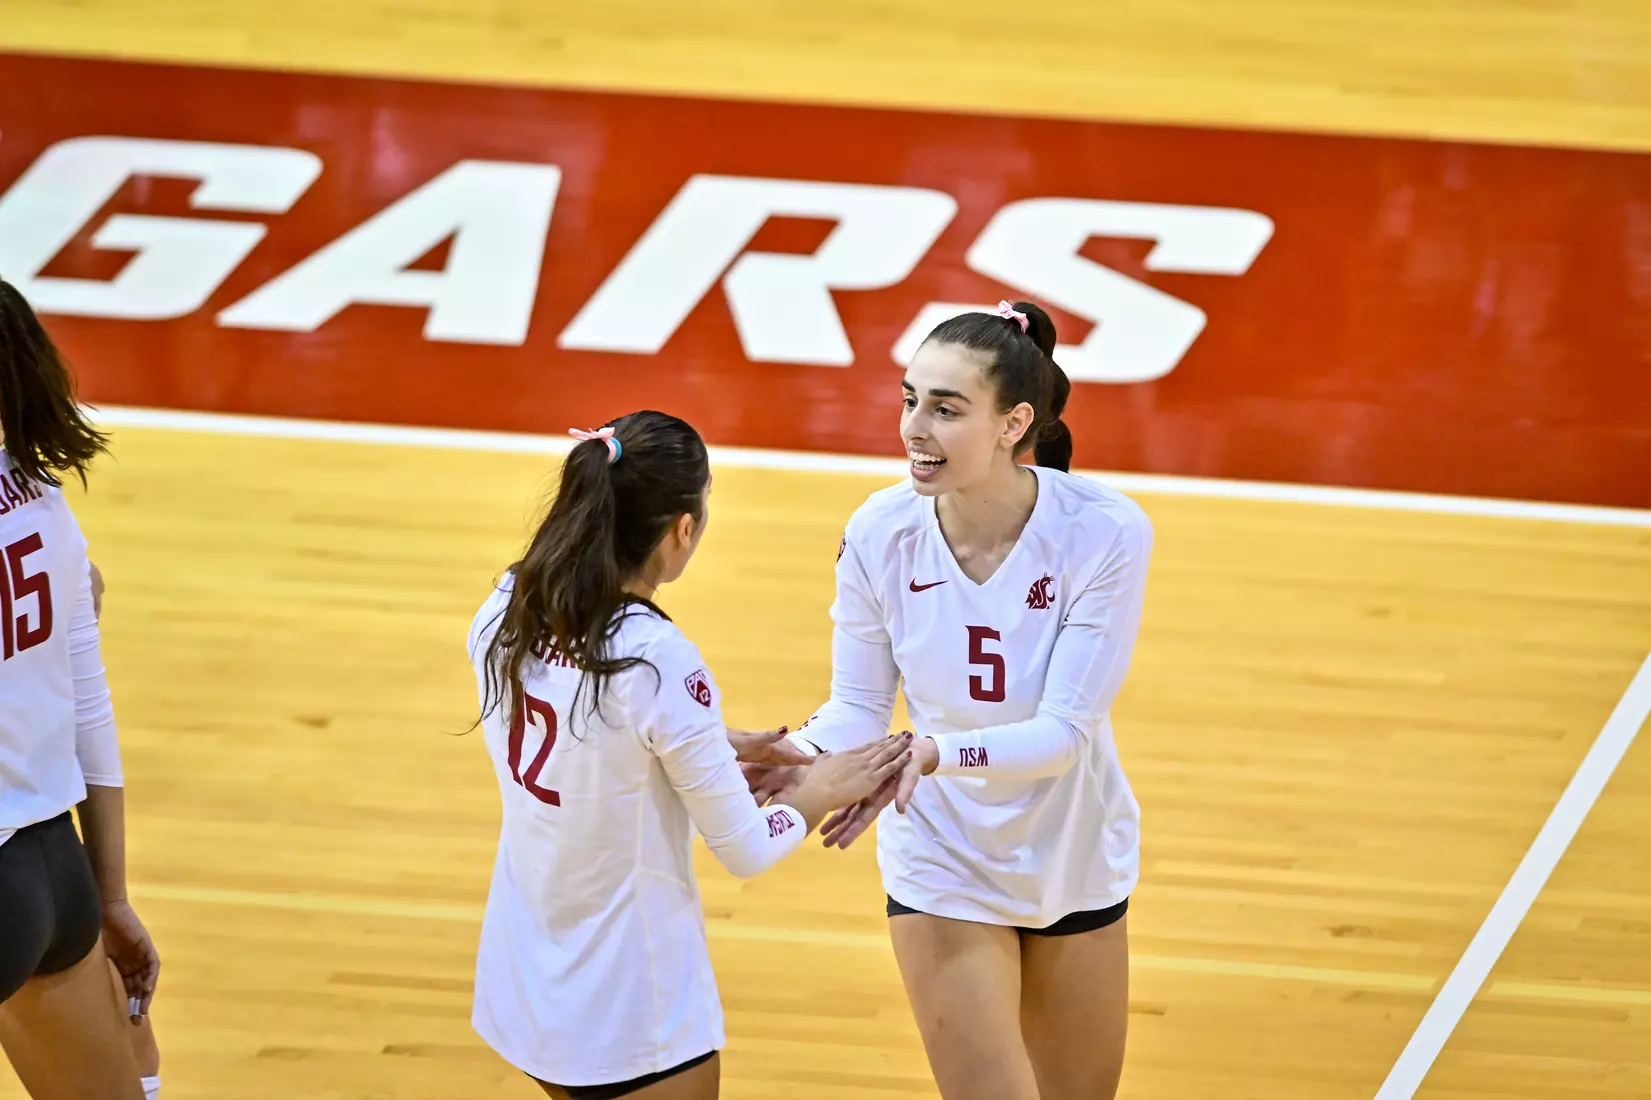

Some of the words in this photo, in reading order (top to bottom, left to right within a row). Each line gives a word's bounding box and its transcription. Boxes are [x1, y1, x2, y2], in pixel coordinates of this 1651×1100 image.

[0, 136, 1274, 383] GARS
[0, 532, 53, 661] 15
[965, 625, 1006, 703] 5
[508, 690, 561, 808] 12
[959, 747, 989, 767] WSU
